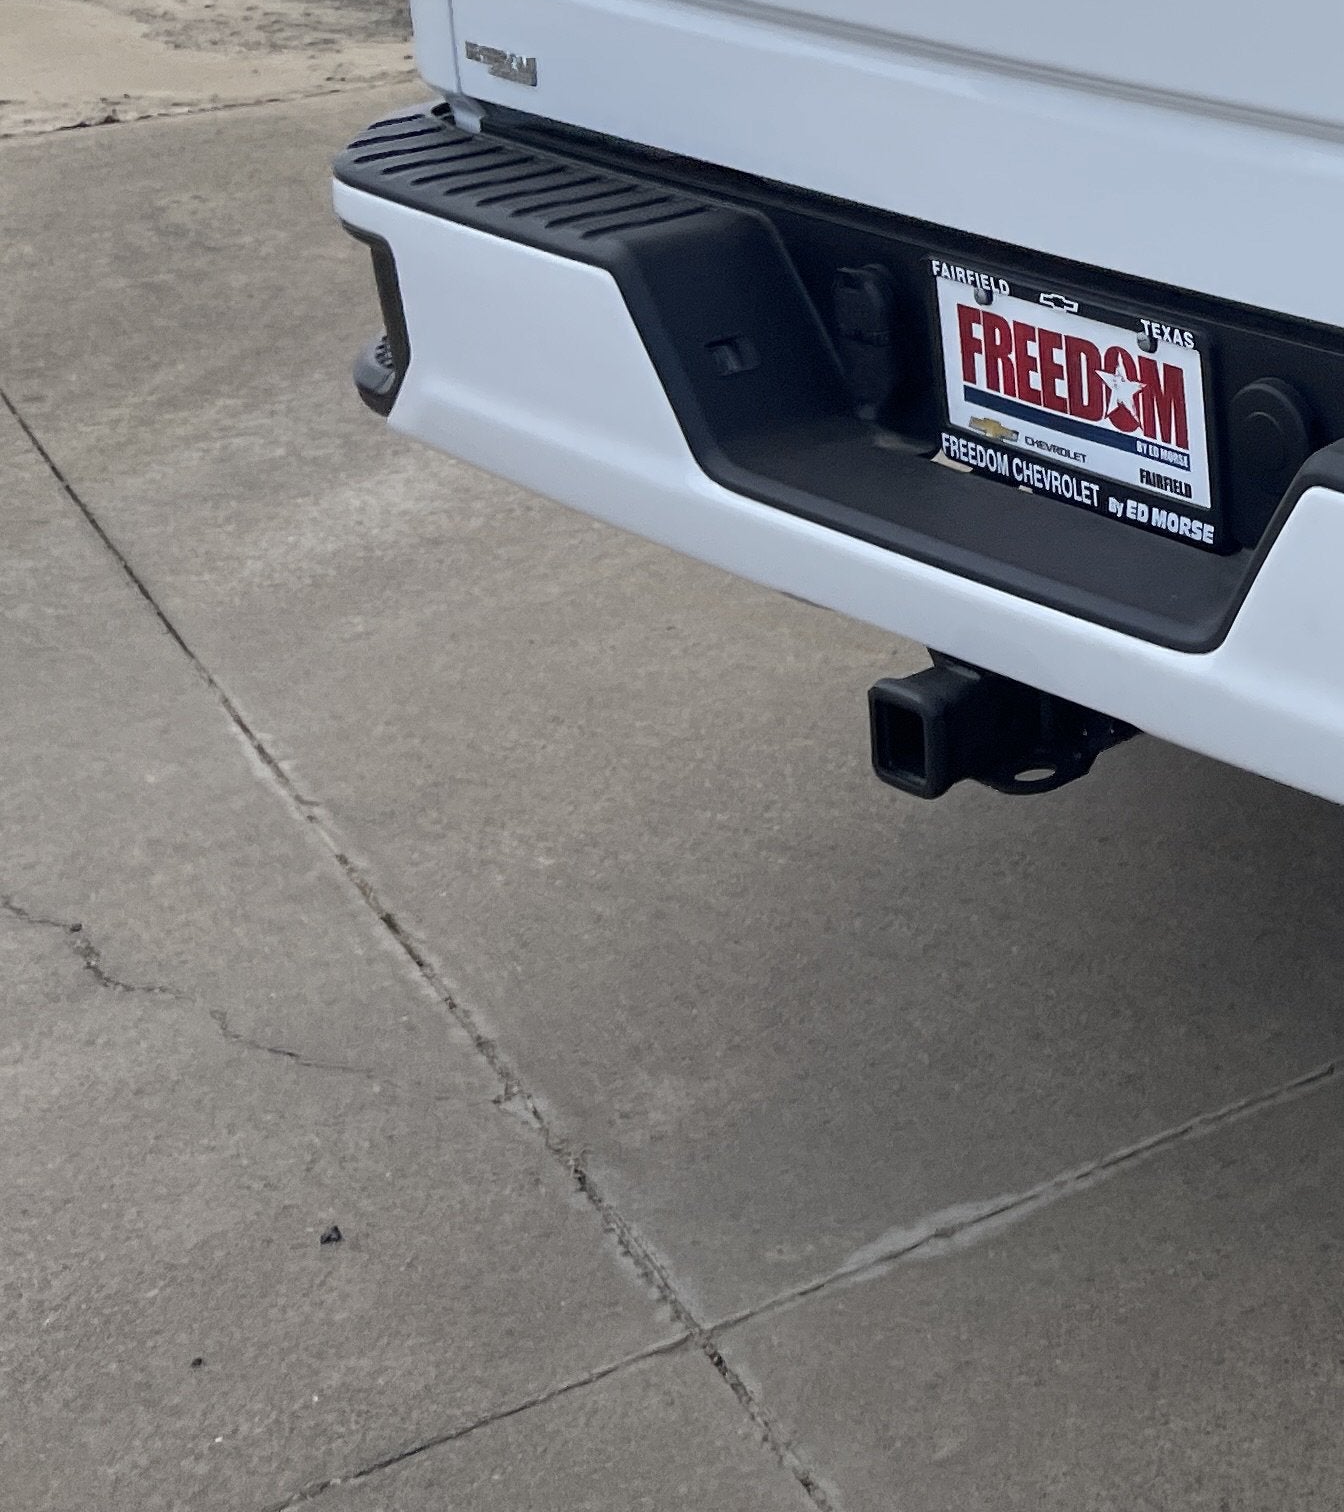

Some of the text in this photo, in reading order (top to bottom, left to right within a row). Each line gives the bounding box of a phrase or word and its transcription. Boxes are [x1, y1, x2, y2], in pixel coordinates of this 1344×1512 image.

[931, 259, 1010, 297] FAIRFIELD
[1140, 318, 1196, 349] TEXAS
[956, 302, 1190, 451] FREEDOM
[1024, 435, 1088, 464] CHEVROLET
[941, 432, 1009, 477] FREEDOM
[1012, 457, 1099, 508] CHEVROLET
[1126, 498, 1149, 523] ED
[1151, 506, 1215, 545] MORSE
[1139, 467, 1192, 499] FAIRFIELD
